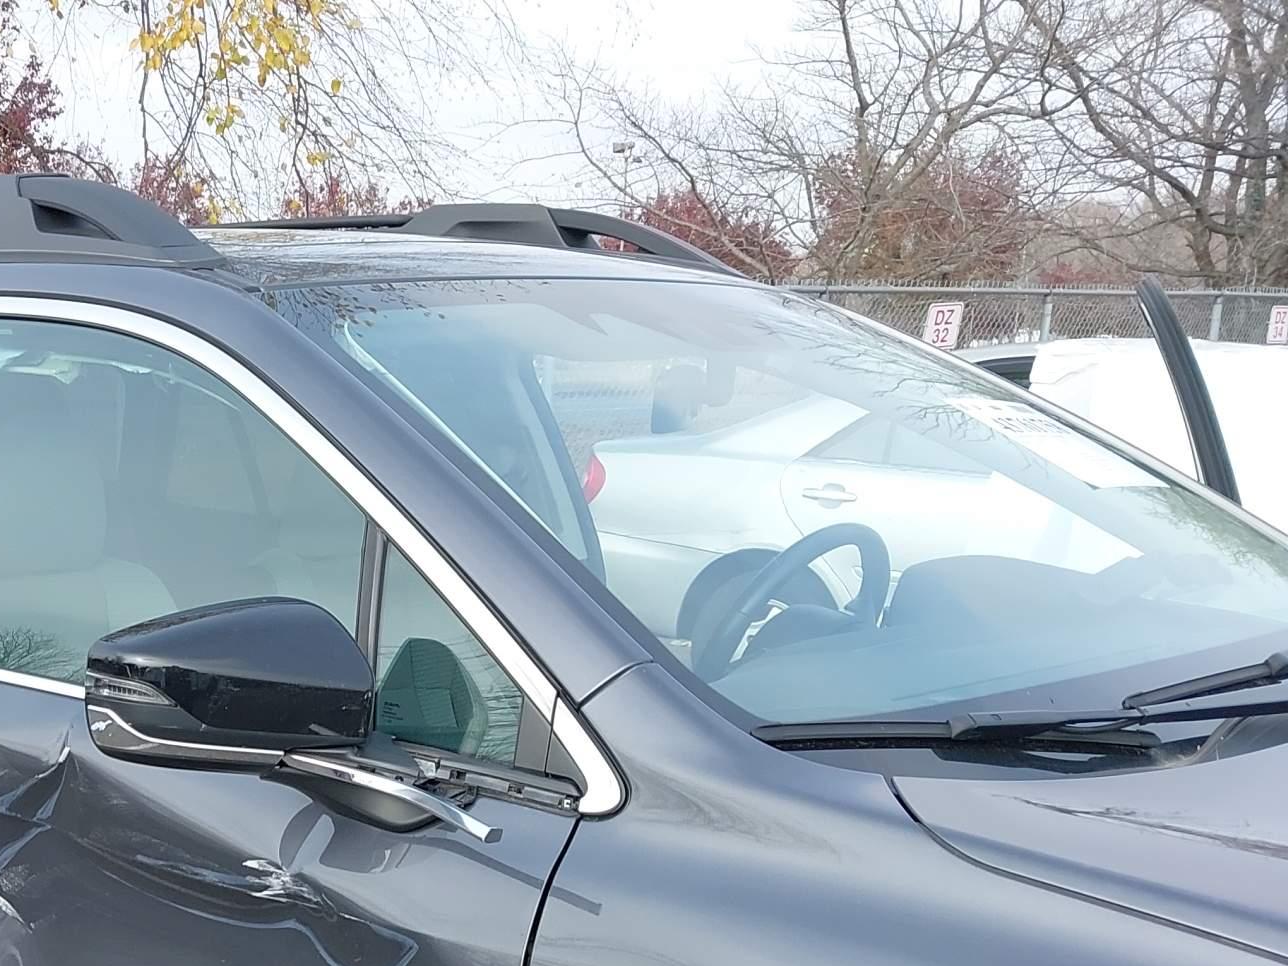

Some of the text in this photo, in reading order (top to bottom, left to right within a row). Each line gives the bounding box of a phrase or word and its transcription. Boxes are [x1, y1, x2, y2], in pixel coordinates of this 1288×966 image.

[934, 310, 955, 326] DZ
[1274, 311, 1287, 325] DZ
[932, 328, 949, 344] 32
